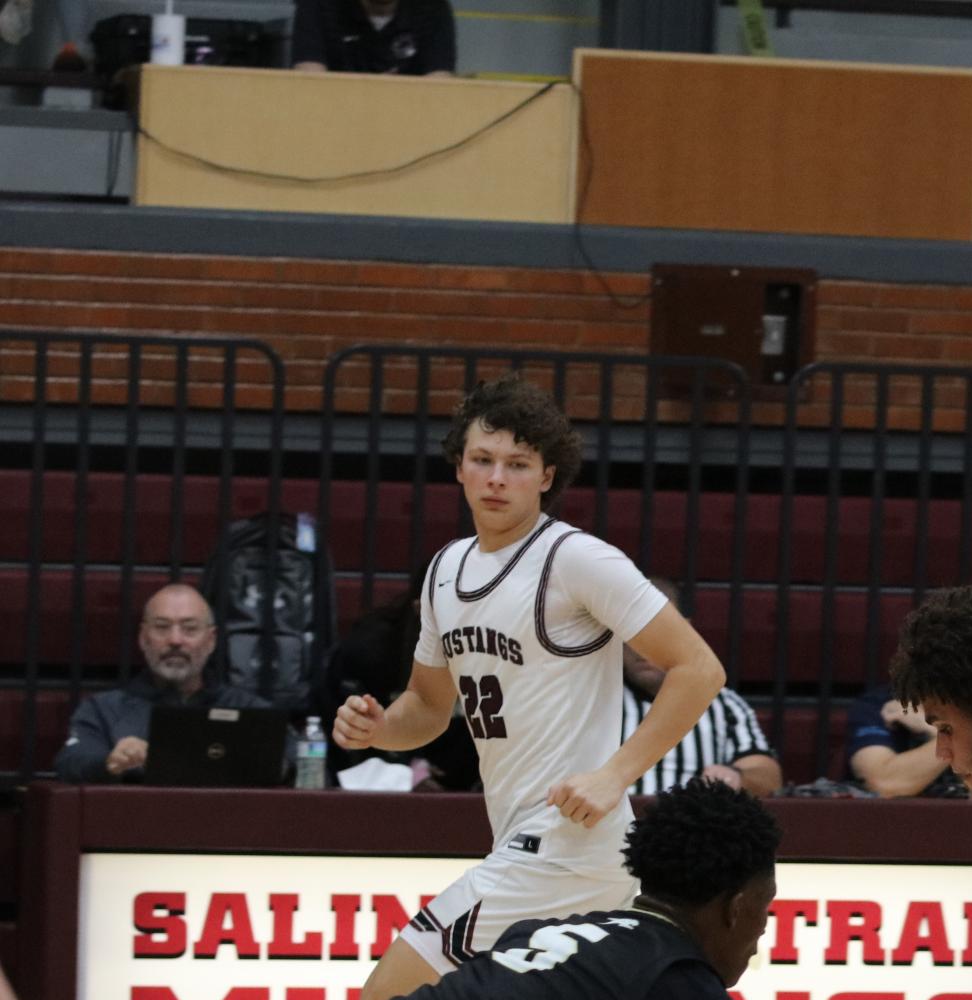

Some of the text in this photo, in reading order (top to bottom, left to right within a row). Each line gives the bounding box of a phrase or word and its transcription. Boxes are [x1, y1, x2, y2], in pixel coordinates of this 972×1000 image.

[442, 626, 524, 665] USTANGS
[459, 675, 507, 739] 22
[133, 891, 437, 960] SALIN
[492, 923, 610, 973] 5
